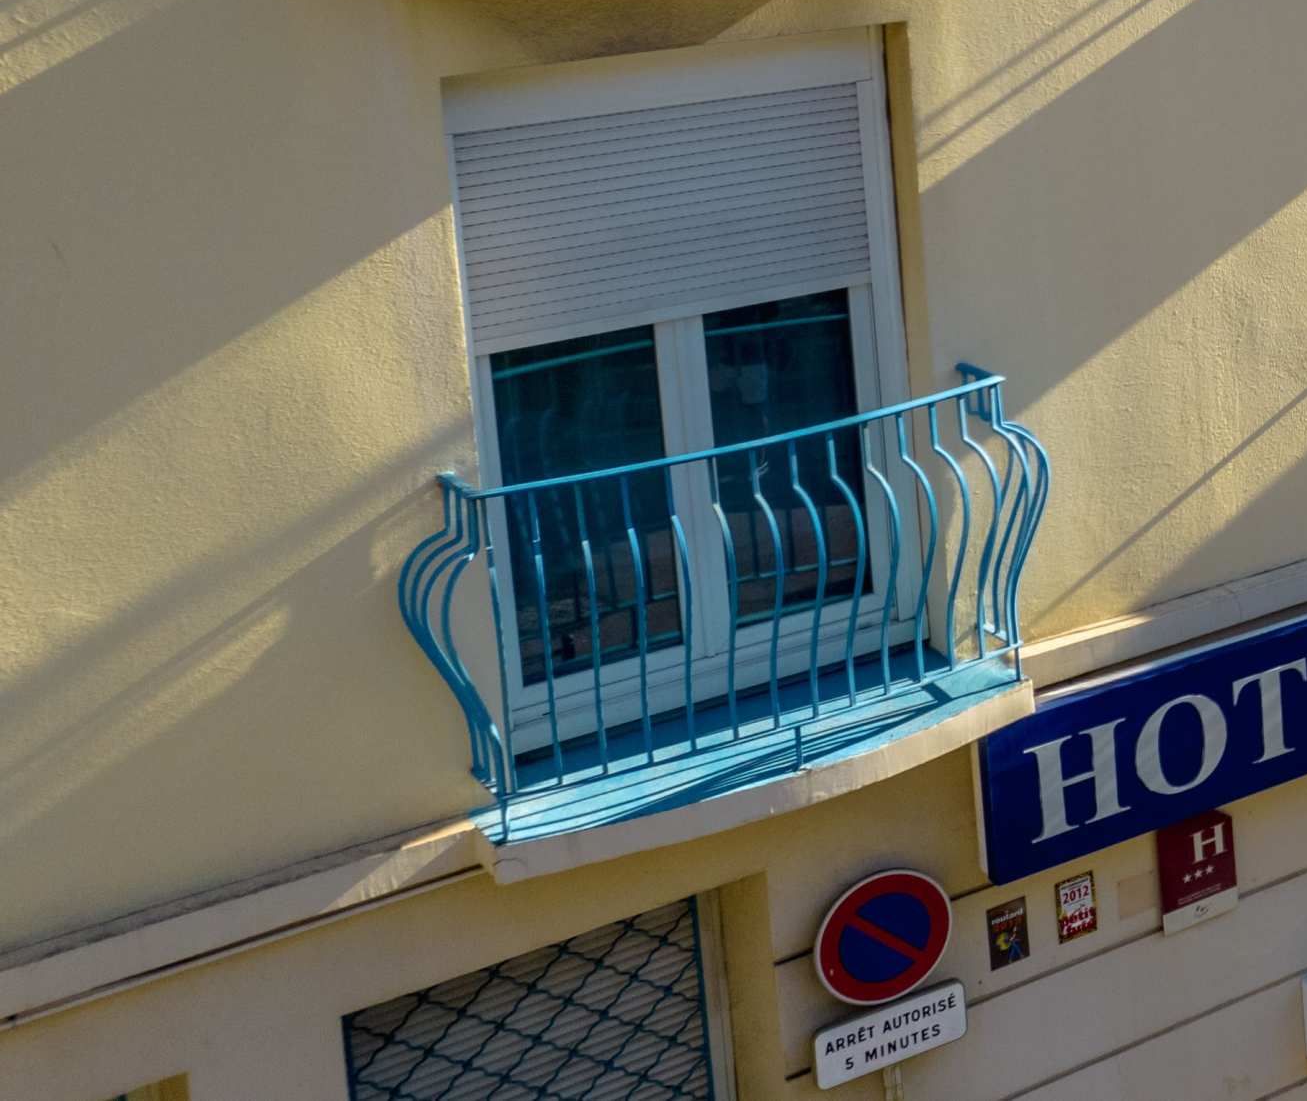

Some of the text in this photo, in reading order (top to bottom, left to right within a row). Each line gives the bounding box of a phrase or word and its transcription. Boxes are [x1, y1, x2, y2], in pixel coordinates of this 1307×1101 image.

[1190, 822, 1228, 865] H
[1062, 885, 1090, 905] 2012
[825, 992, 956, 1056] ARRÊT AUTORISÉ
[845, 1024, 941, 1070] 5 MINUTES
